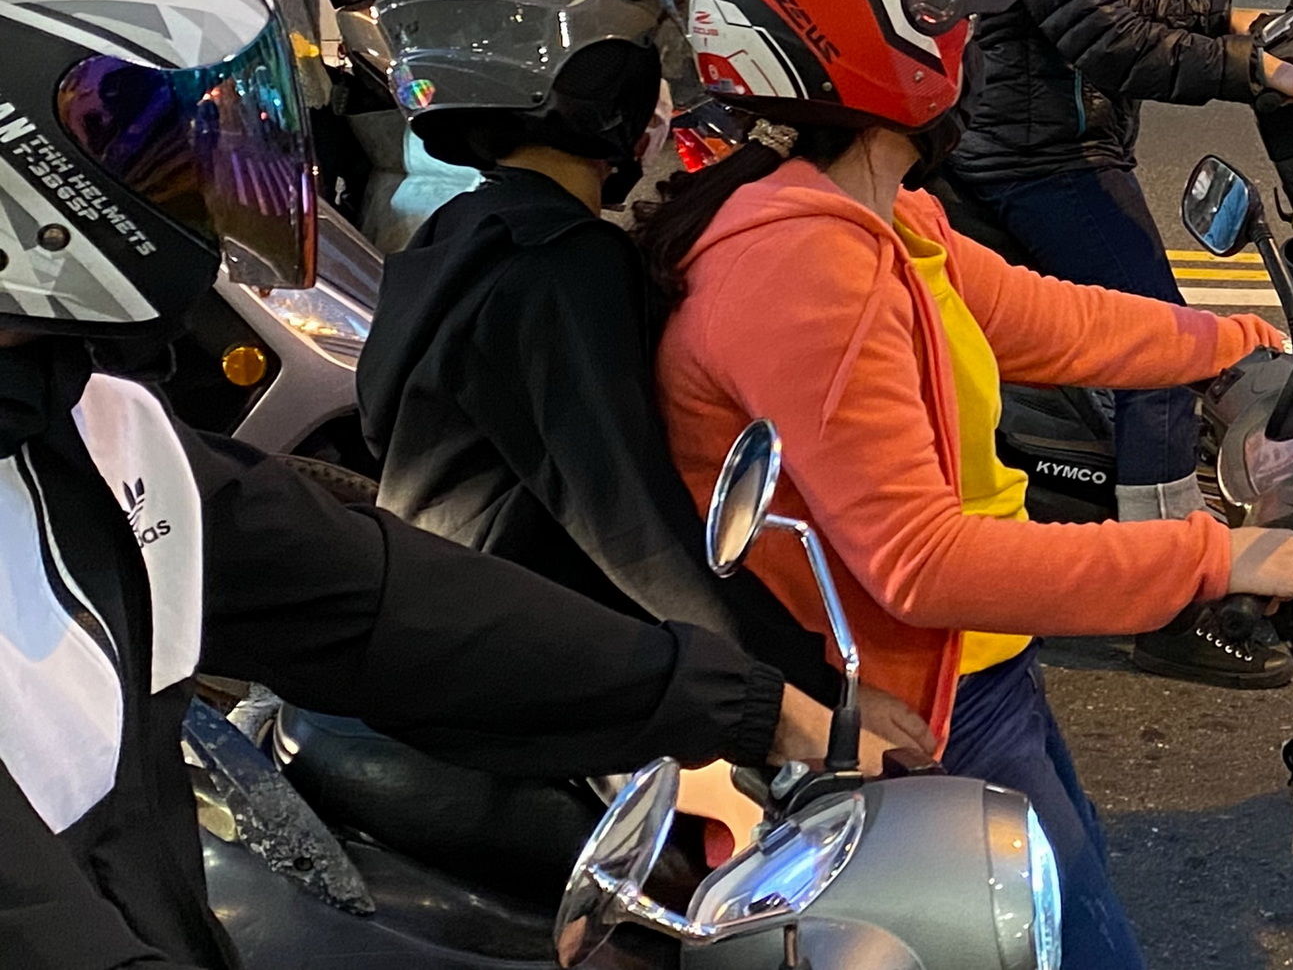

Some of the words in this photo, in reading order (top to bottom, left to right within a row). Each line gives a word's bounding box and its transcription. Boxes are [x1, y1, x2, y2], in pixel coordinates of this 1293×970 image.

[30, 134, 74, 173] THH
[68, 173, 157, 256] HELMETS
[1036, 460, 1107, 485] KYMCO
